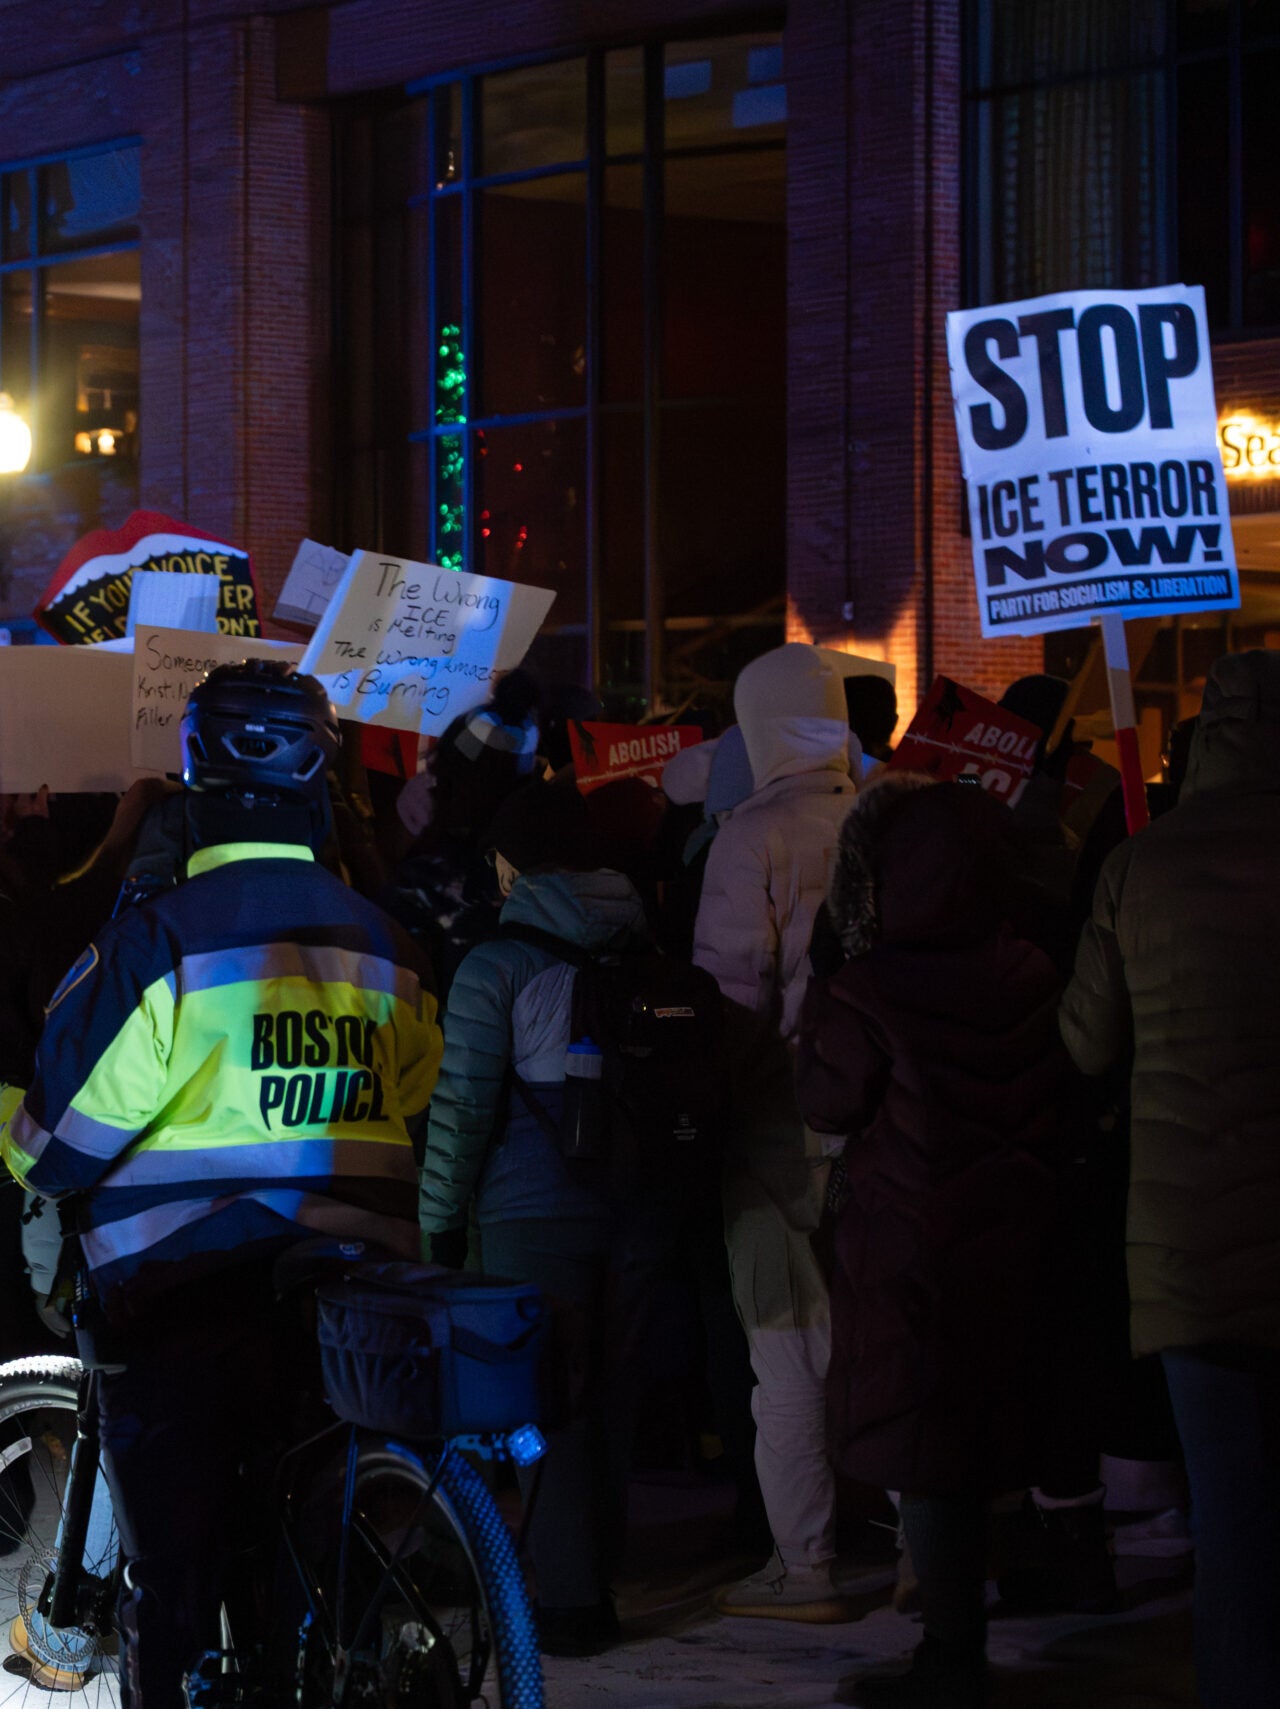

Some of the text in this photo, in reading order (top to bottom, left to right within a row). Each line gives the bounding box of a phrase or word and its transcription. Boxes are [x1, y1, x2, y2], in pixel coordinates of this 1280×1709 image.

[963, 302, 1201, 451] STOP
[977, 460, 1218, 540] ICE TERROR
[984, 524, 1224, 587] NOW!
[64, 600, 97, 634] IF
[376, 562, 421, 601] The
[432, 574, 500, 632] Wrong
[404, 605, 450, 628] ICE
[990, 575, 1228, 620] PARTY FOR SOCIALISM & LIBERATION
[608, 731, 681, 766] ABOLISH
